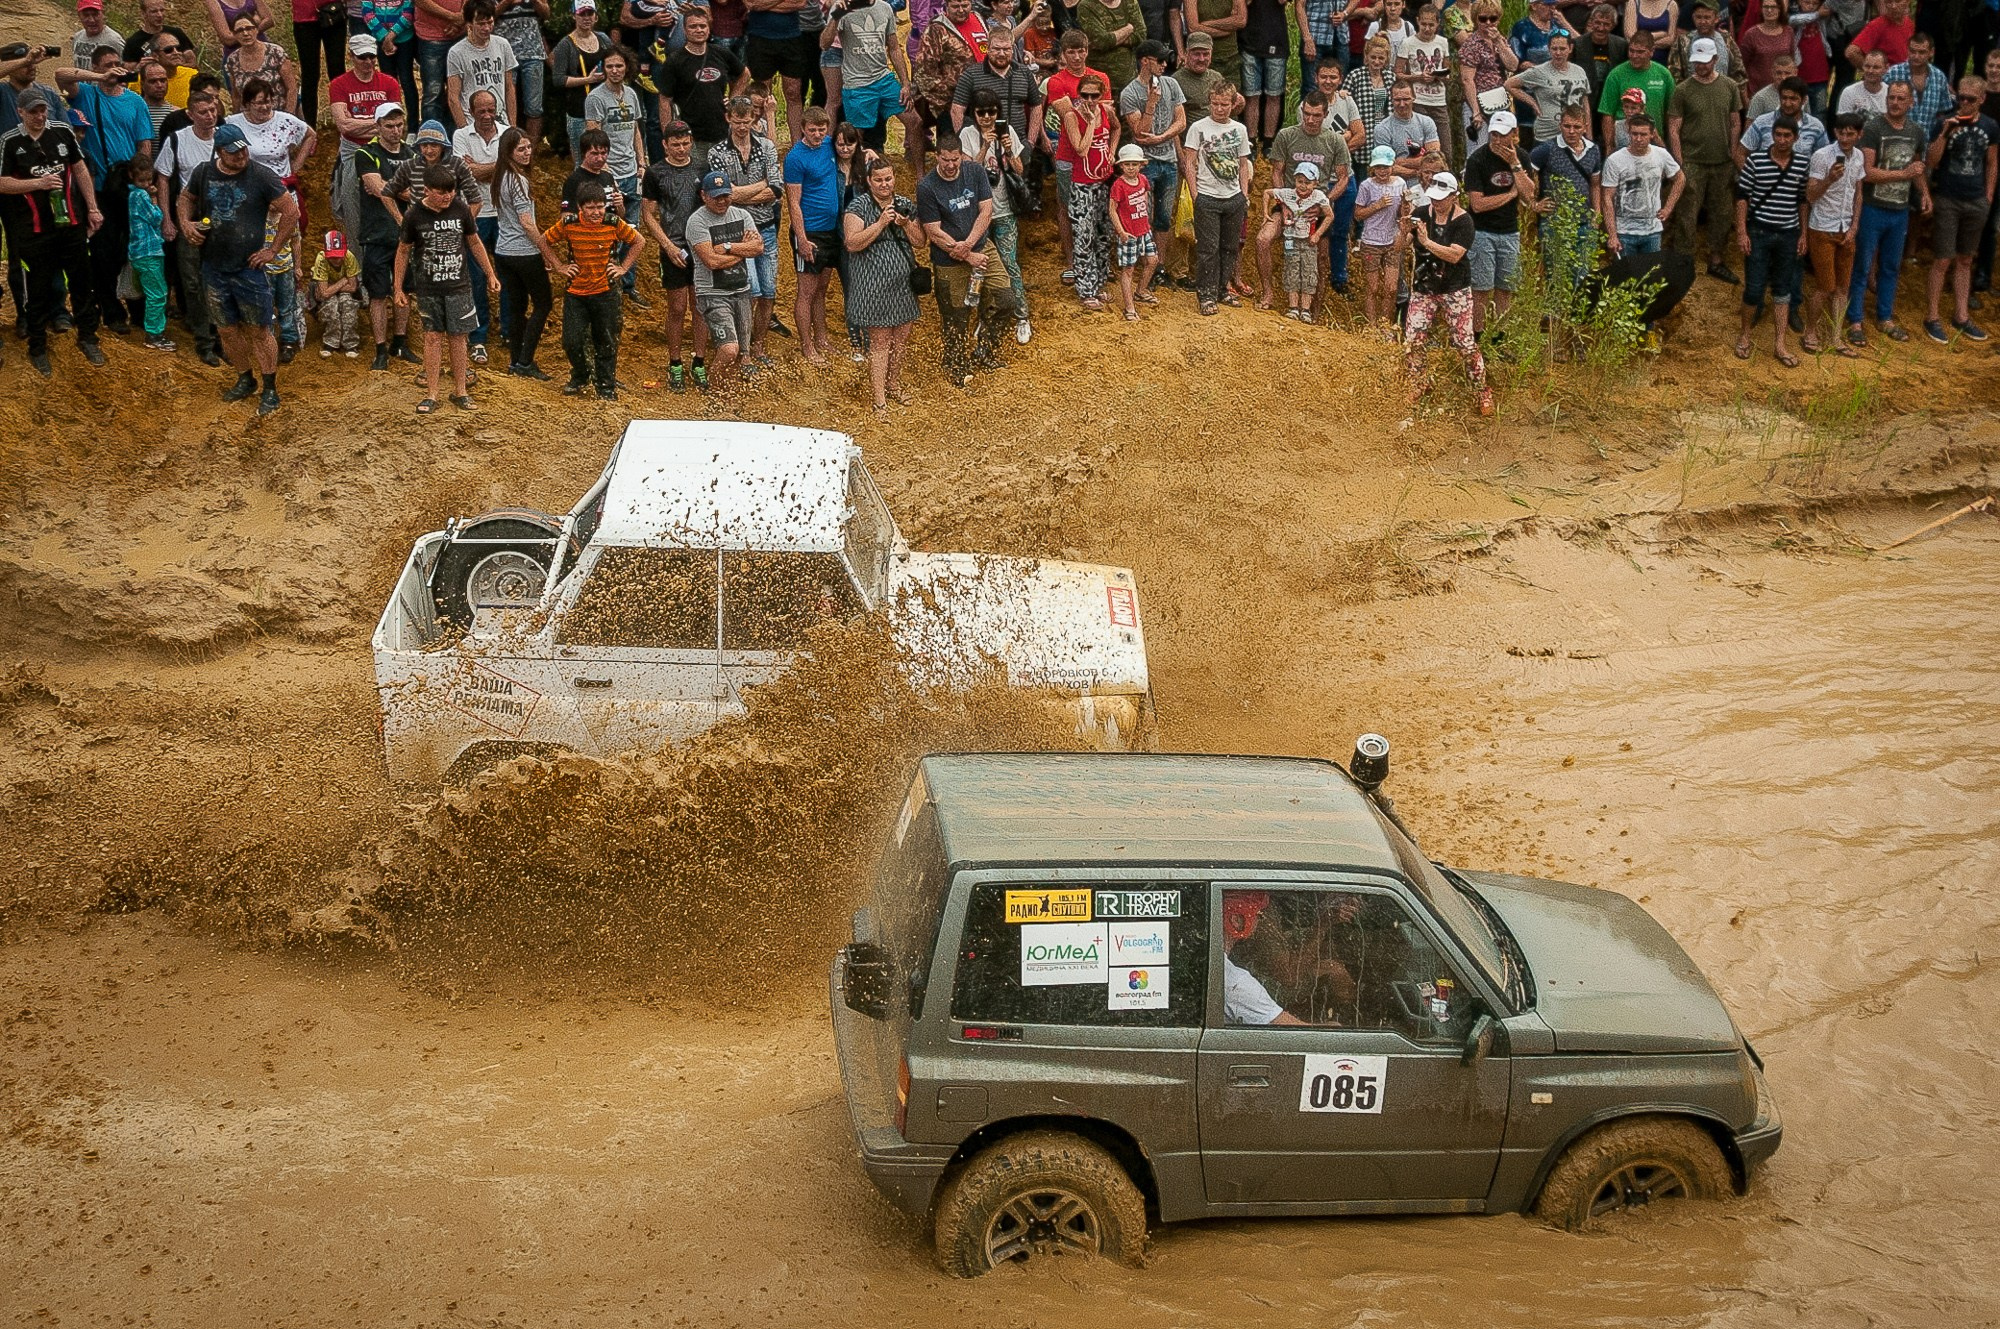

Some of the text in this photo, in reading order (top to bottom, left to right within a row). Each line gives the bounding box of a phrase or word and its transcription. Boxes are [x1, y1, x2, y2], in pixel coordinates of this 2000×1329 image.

[434, 219, 462, 231] COME
[470, 675, 513, 695] ВАША
[453, 690, 524, 717] РЕКЛАМА
[1126, 893, 1178, 905] TROPHY
[1010, 904, 1038, 918] РАДИО
[1126, 903, 1174, 915] TRAVEL
[1309, 1074, 1378, 1110] 085
